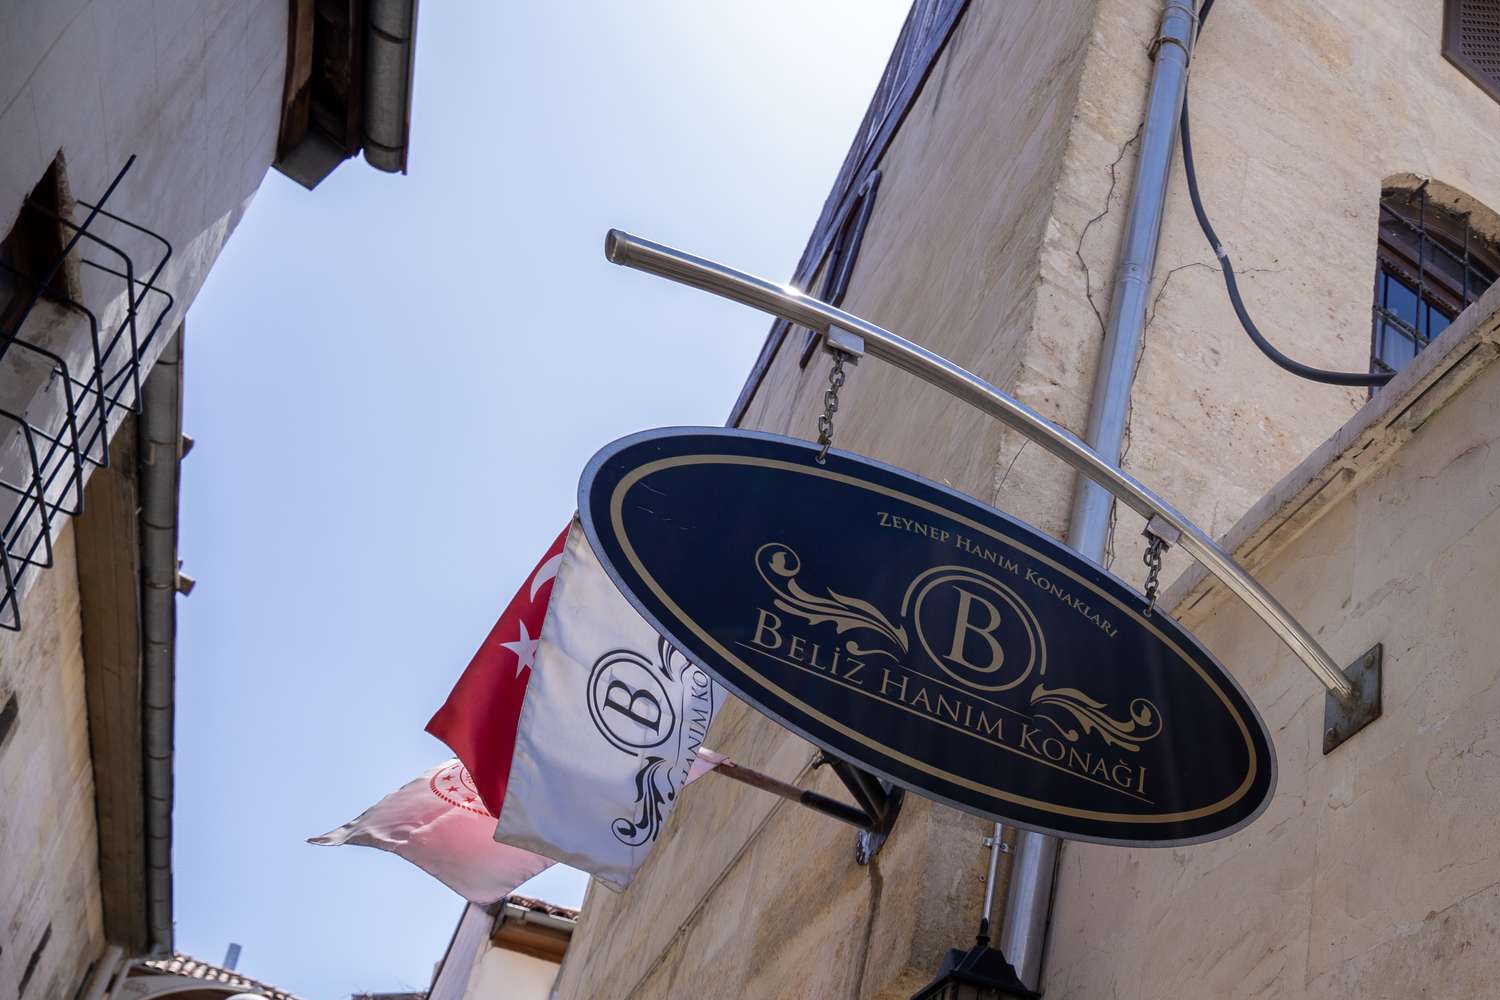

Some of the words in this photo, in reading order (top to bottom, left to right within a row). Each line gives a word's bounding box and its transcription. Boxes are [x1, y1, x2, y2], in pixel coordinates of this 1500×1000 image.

[877, 511, 950, 543] ZEYNEP
[955, 532, 1019, 575] HANIM
[1024, 567, 1119, 639] KONAKLARI
[943, 585, 1005, 674] B
[751, 608, 864, 685] BELİZ
[881, 668, 1004, 741] HANIM
[1019, 723, 1147, 795] KONAĞI
